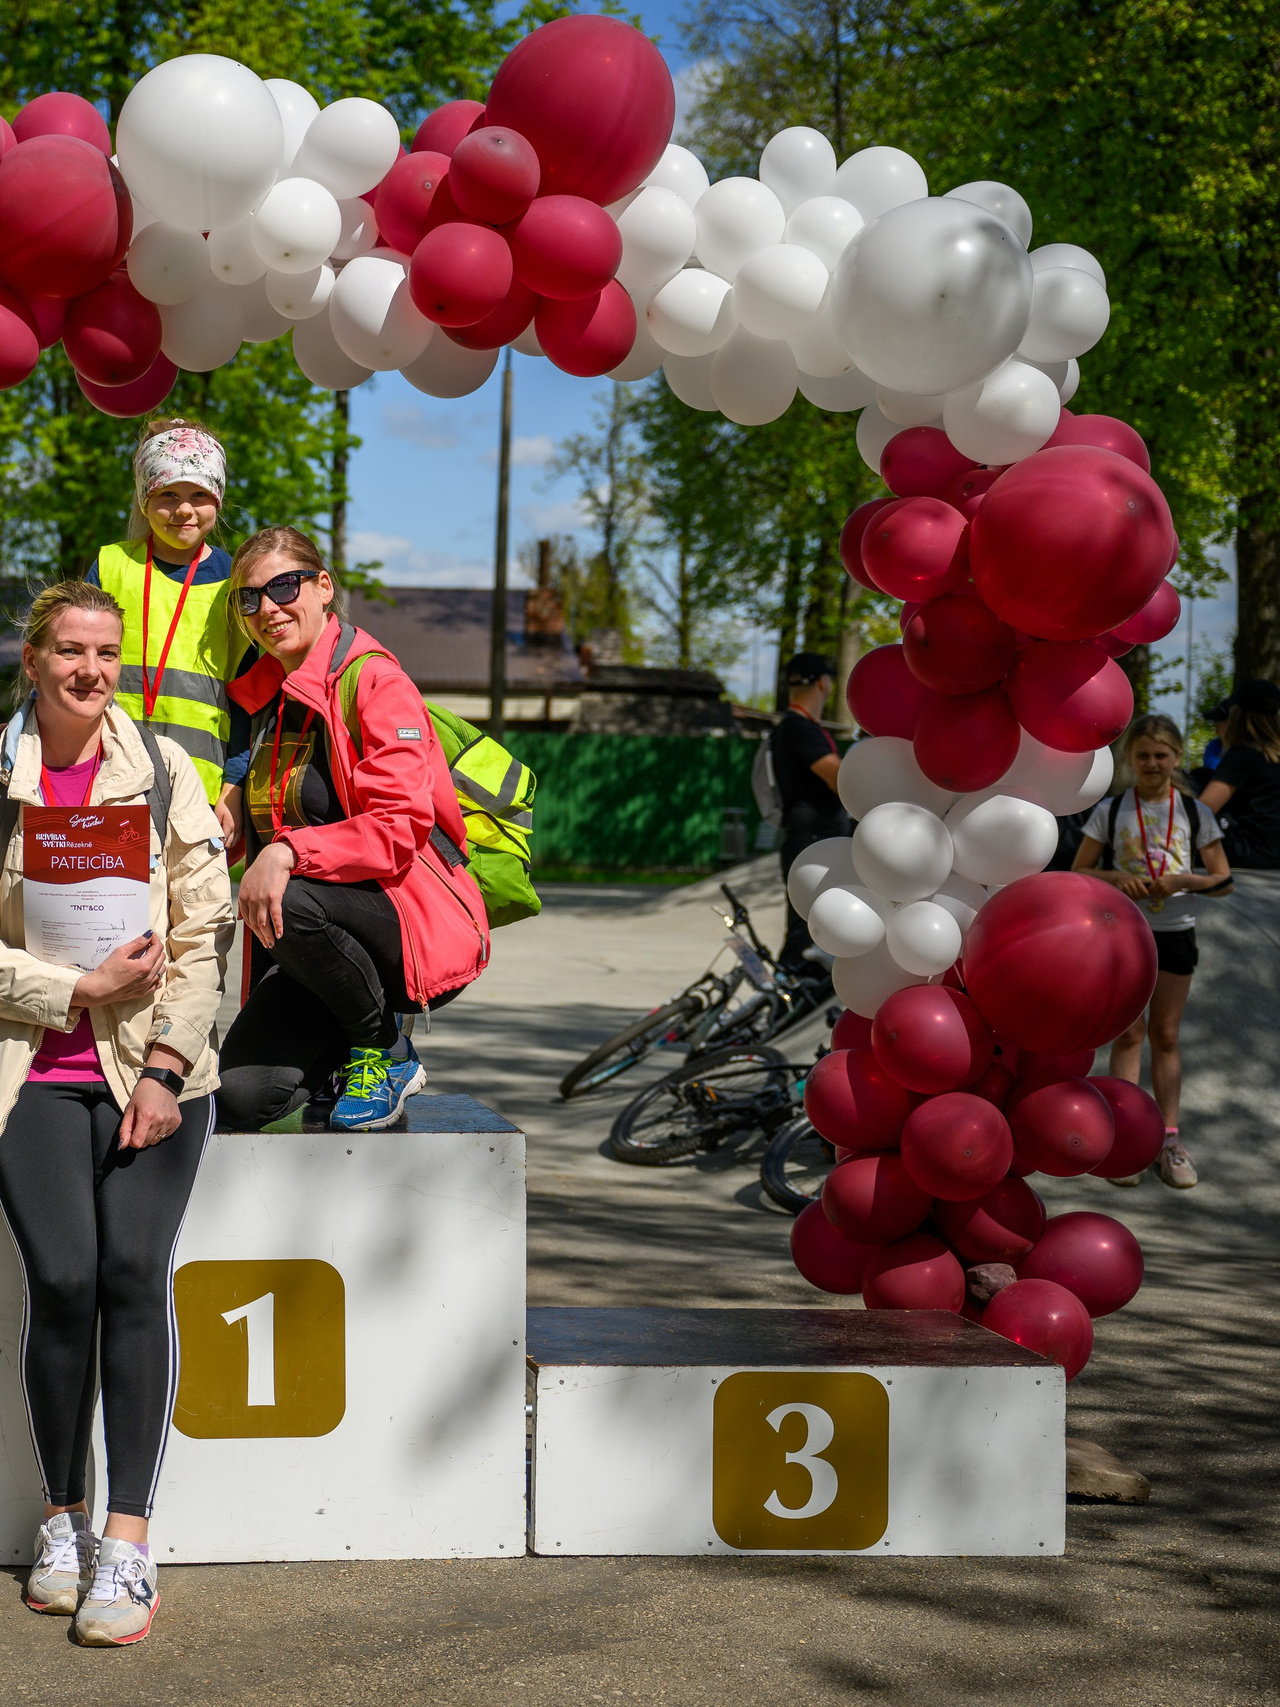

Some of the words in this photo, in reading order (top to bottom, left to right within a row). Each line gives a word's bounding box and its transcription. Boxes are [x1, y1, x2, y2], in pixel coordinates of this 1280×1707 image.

[51, 853, 125, 870] PATEICĪBA
[220, 1291, 276, 1406] 1
[763, 1402, 839, 1519] 3
